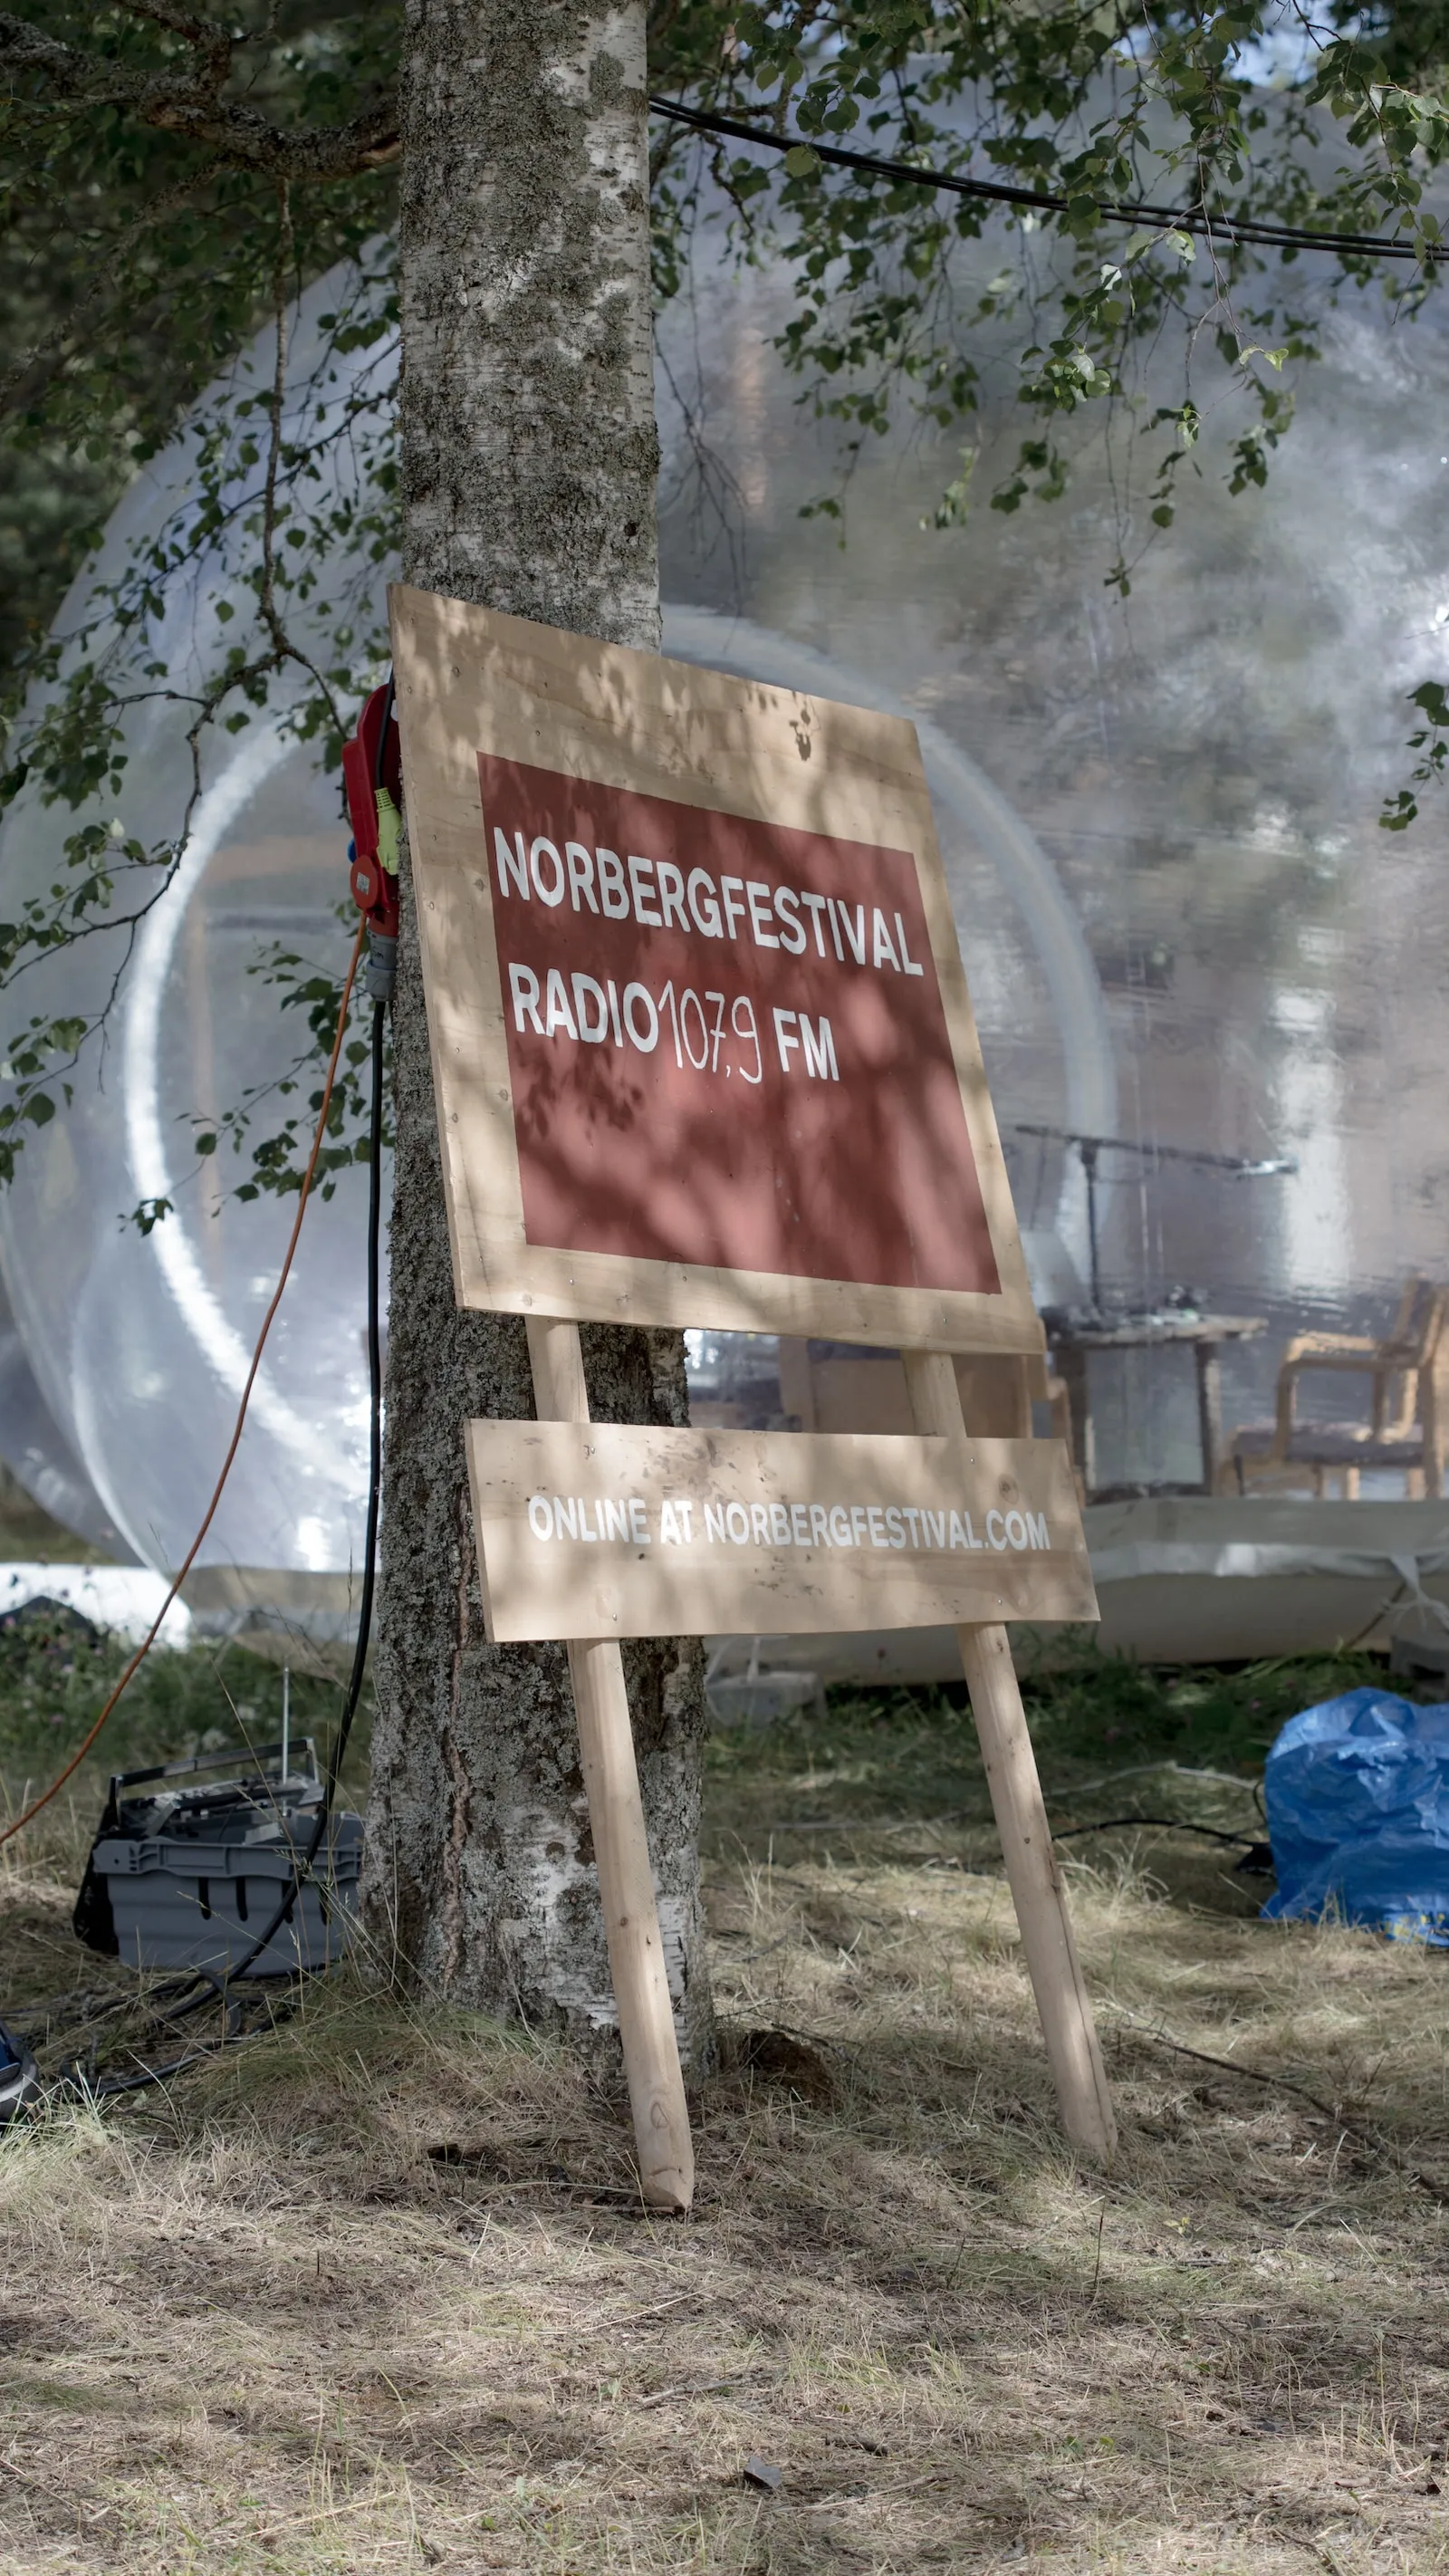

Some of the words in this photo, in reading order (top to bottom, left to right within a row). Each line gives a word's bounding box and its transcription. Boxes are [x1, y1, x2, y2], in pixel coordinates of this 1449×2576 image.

[494, 827, 924, 976] NORBERGFESTIVAL
[508, 962, 659, 1053] RADIO
[772, 1007, 840, 1081] FM
[528, 1495, 651, 1543] ONLINE
[660, 1500, 693, 1545] AT
[704, 1502, 1051, 1551] NORBERGFESTIVAL.COM
